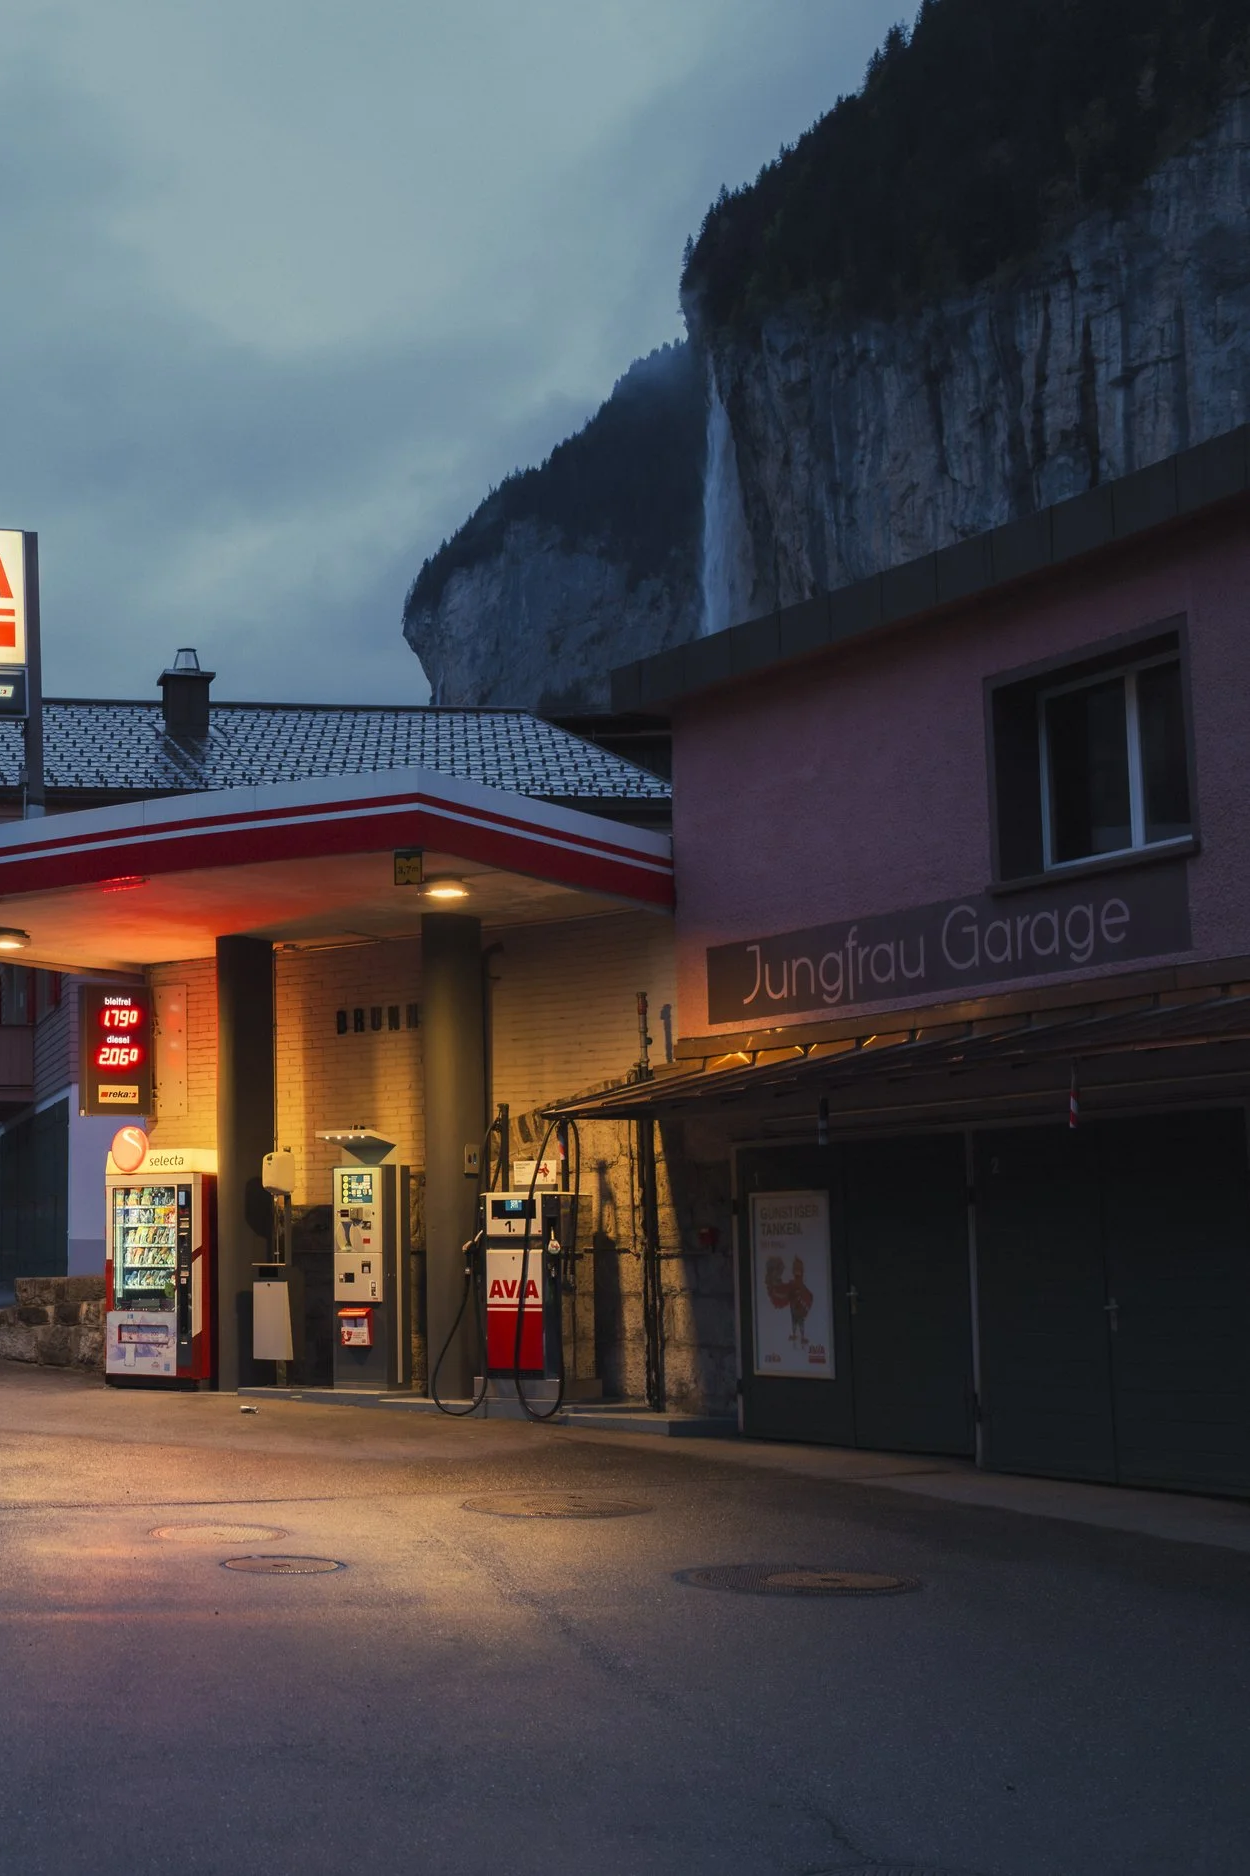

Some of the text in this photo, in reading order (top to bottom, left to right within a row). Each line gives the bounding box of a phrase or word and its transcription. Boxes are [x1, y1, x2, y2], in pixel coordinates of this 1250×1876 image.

[742, 897, 1131, 1006] Jungfrau Garage
[104, 997, 132, 1007] bleifrei
[106, 1035, 130, 1045] diesel
[149, 1154, 184, 1167] selecta
